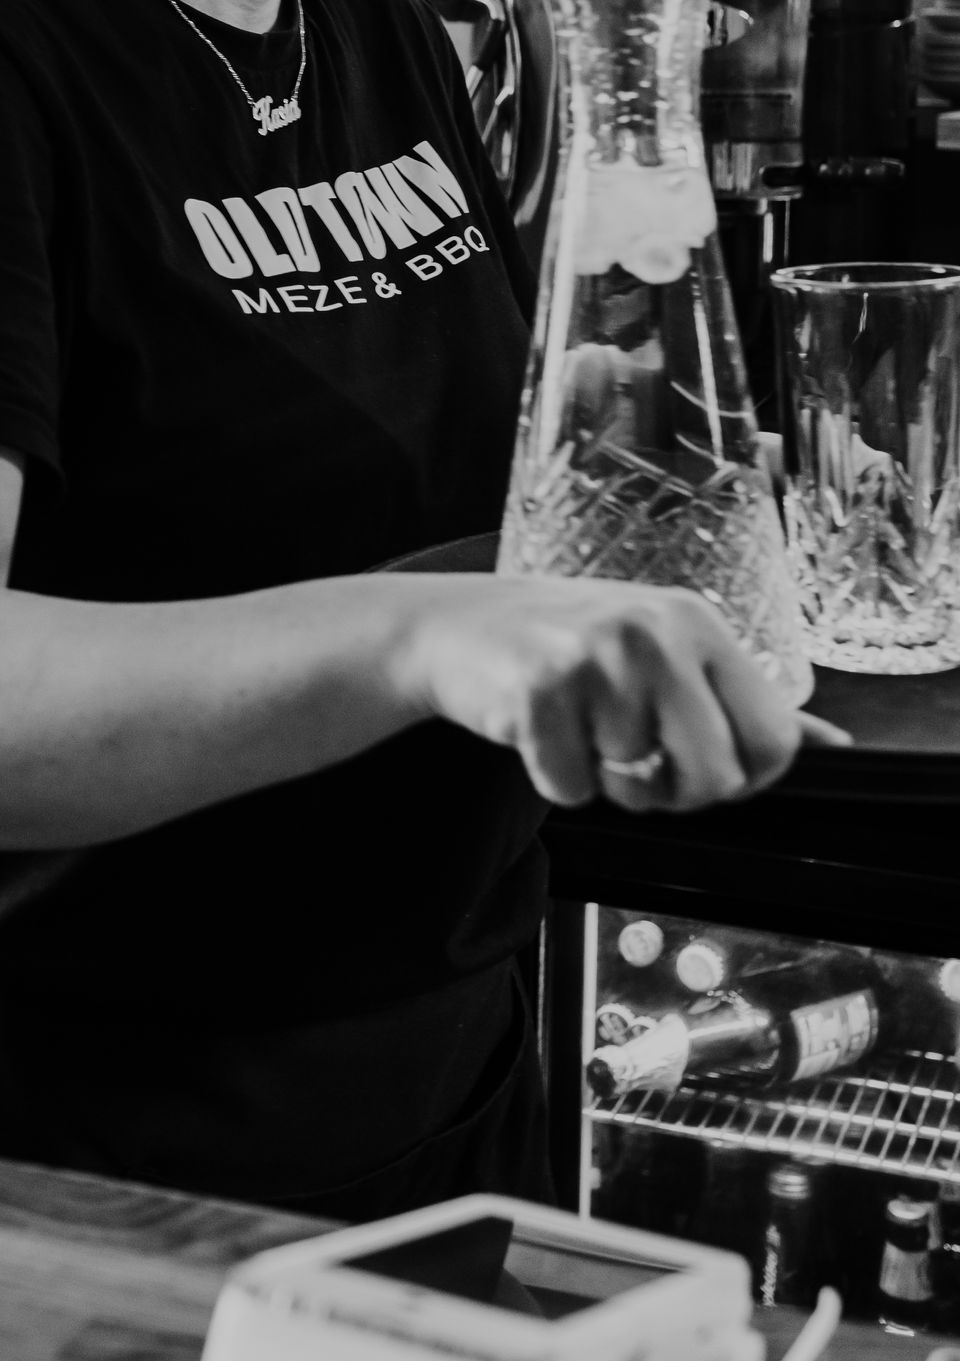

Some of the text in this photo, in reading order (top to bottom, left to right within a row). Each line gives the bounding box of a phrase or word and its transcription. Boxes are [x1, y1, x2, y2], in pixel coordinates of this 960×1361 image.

[184, 140, 470, 280] OLDTOWN
[231, 225, 490, 315] MEZE & BBQ
